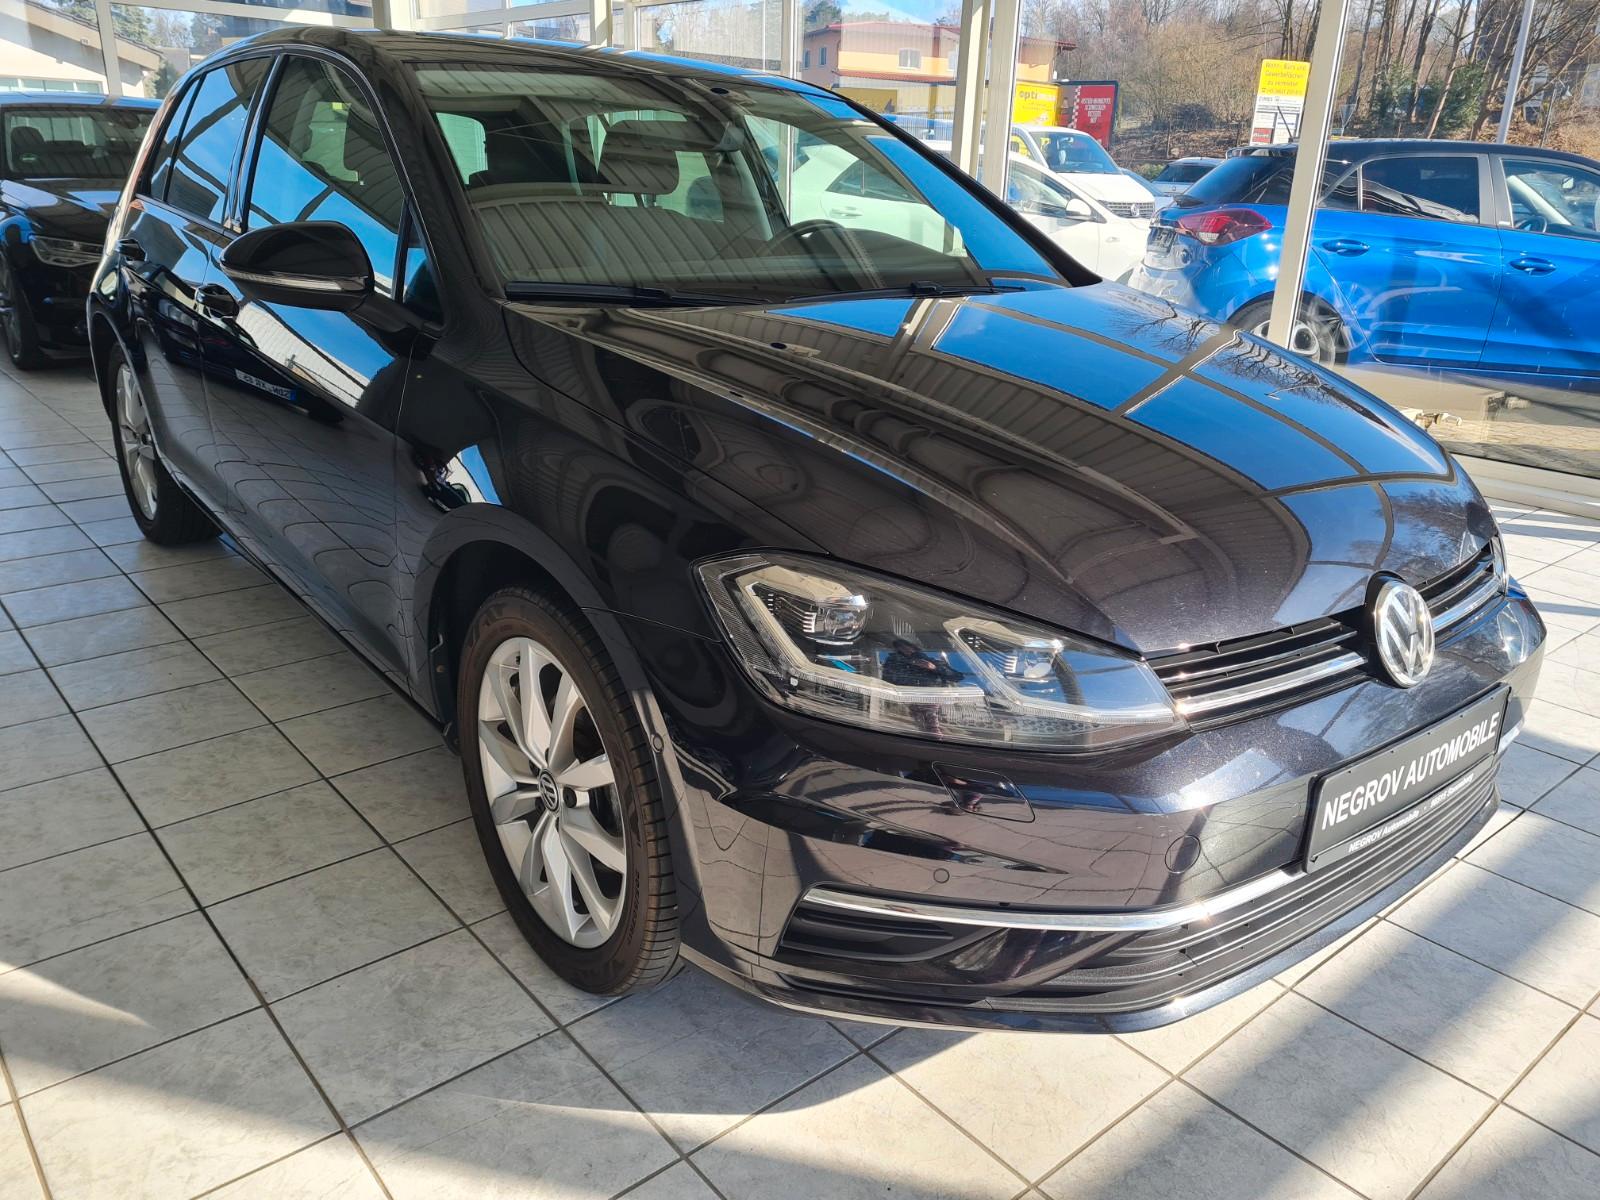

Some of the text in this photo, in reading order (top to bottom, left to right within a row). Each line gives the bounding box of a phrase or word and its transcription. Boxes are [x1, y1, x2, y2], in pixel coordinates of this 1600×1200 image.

[1321, 711, 1500, 831] NEGROV AUTOMOBILE
[1348, 829, 1384, 853] NEGROV
